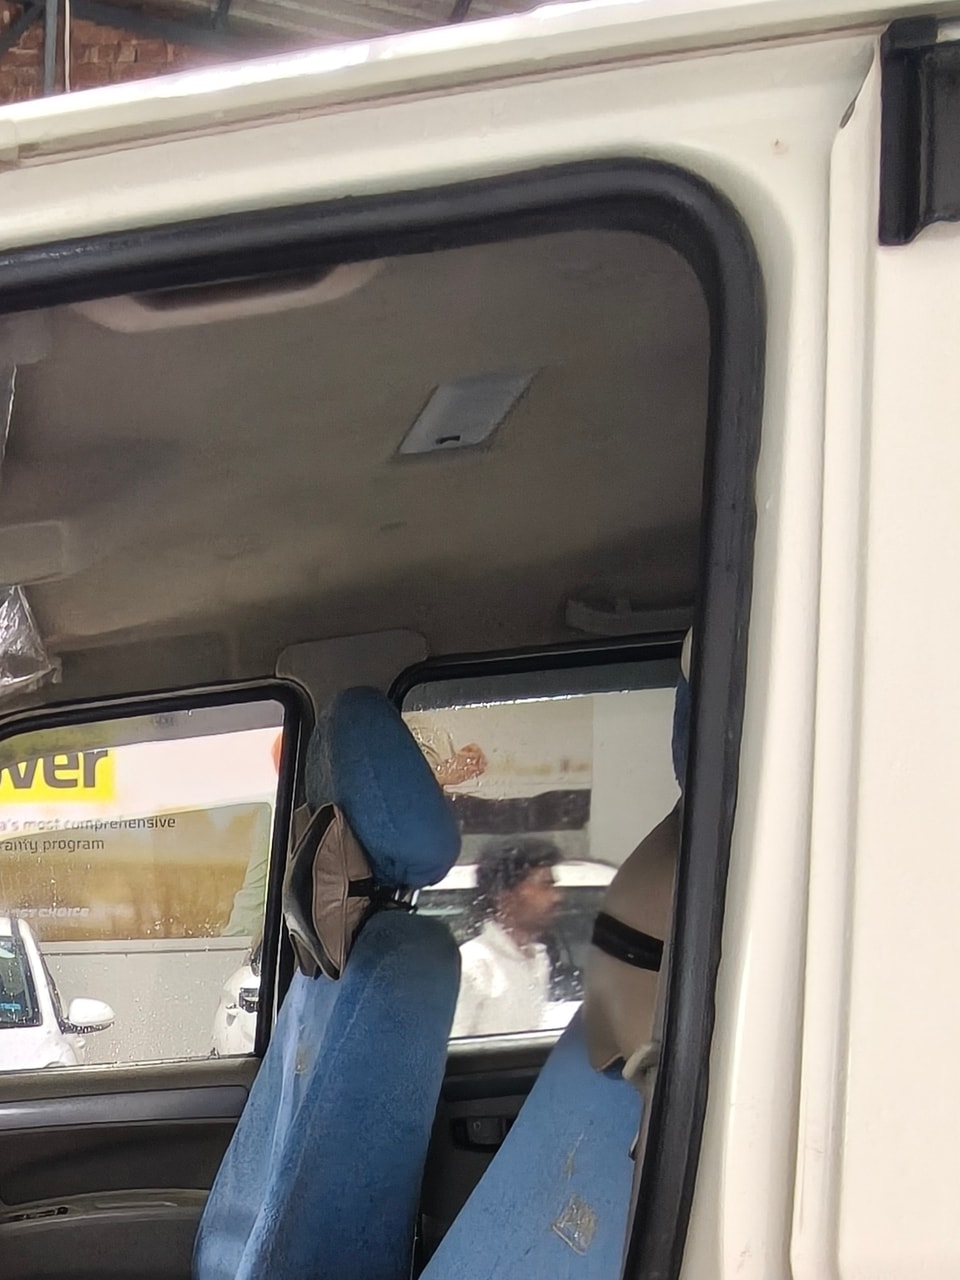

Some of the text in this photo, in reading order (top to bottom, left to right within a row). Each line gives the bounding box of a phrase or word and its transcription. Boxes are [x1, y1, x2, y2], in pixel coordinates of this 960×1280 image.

[23, 818, 60, 831] most
[63, 815, 176, 833] comprehensive
[43, 837, 105, 853] program
